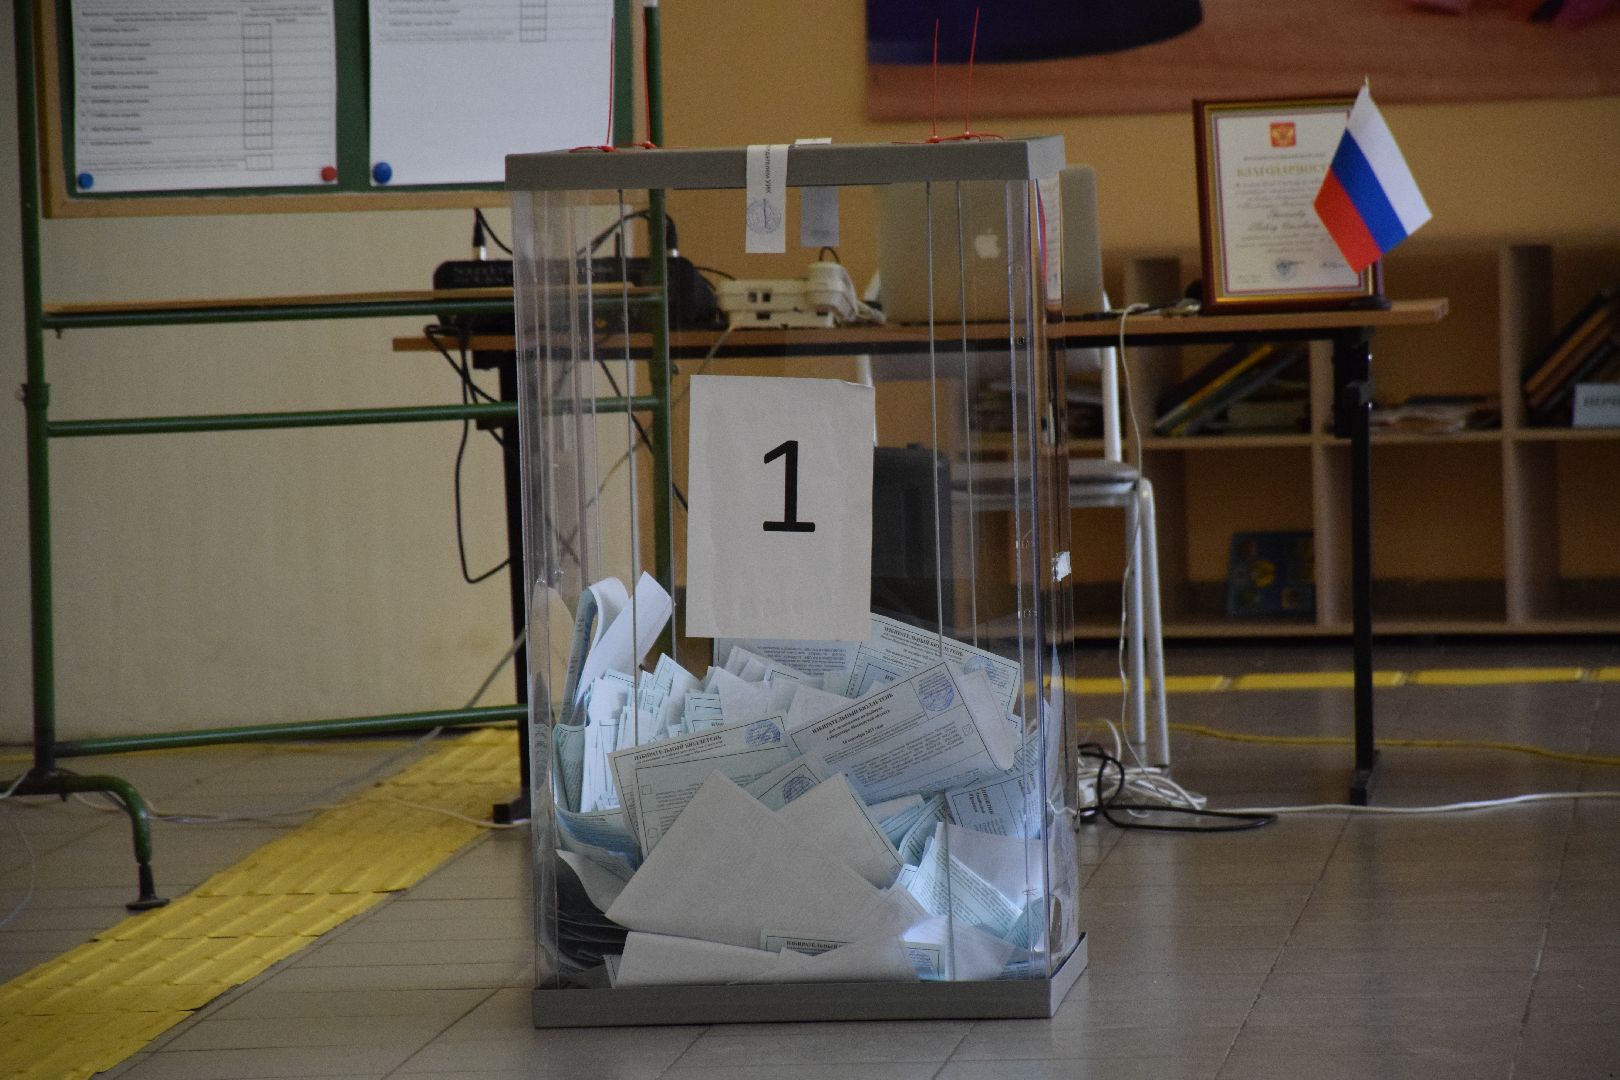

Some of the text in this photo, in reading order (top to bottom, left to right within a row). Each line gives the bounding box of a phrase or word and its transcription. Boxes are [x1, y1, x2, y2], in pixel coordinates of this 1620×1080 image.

[763, 440, 815, 532] 1
[811, 693, 894, 734] ИЗБИРАТЕЛЬНЫЙ БЮЛЛЕТЕНЬ
[634, 744, 684, 761] ИЗБИРАТЕЛЬНЫЙ
[684, 735, 722, 749] БЮЛЛЕТЕНЬ
